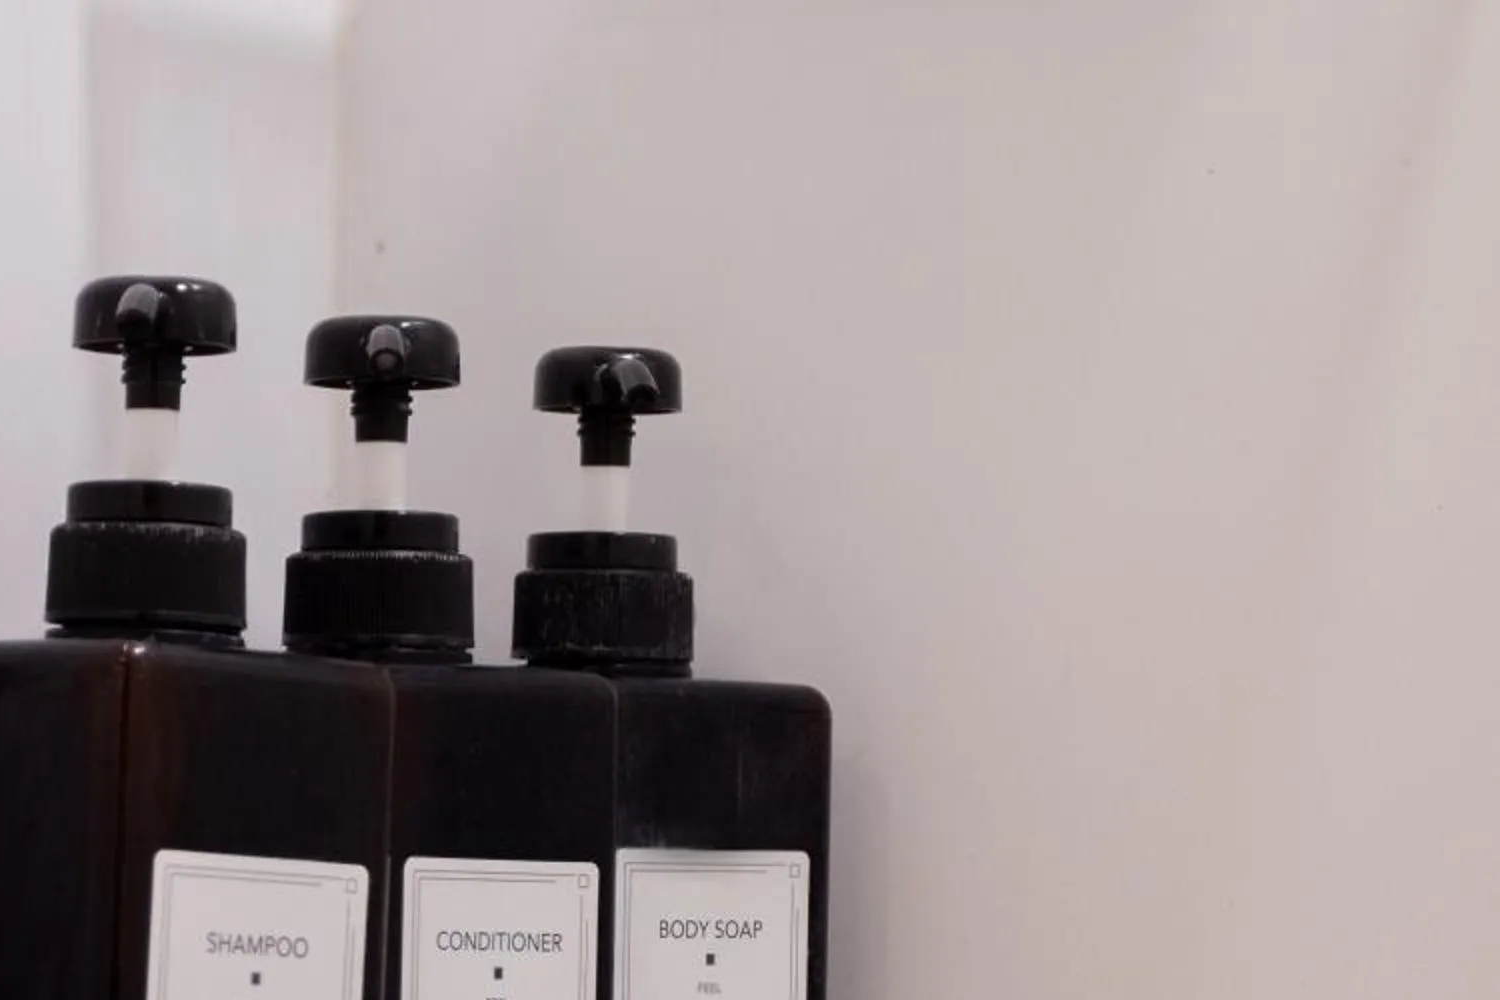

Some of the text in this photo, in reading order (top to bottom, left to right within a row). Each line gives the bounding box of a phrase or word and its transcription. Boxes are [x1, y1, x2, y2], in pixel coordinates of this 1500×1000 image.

[659, 919, 763, 939] BODY SOAP
[206, 931, 309, 959] SHAMPOO
[436, 931, 562, 953] CONDITIONER
[697, 982, 722, 995] FEEL
